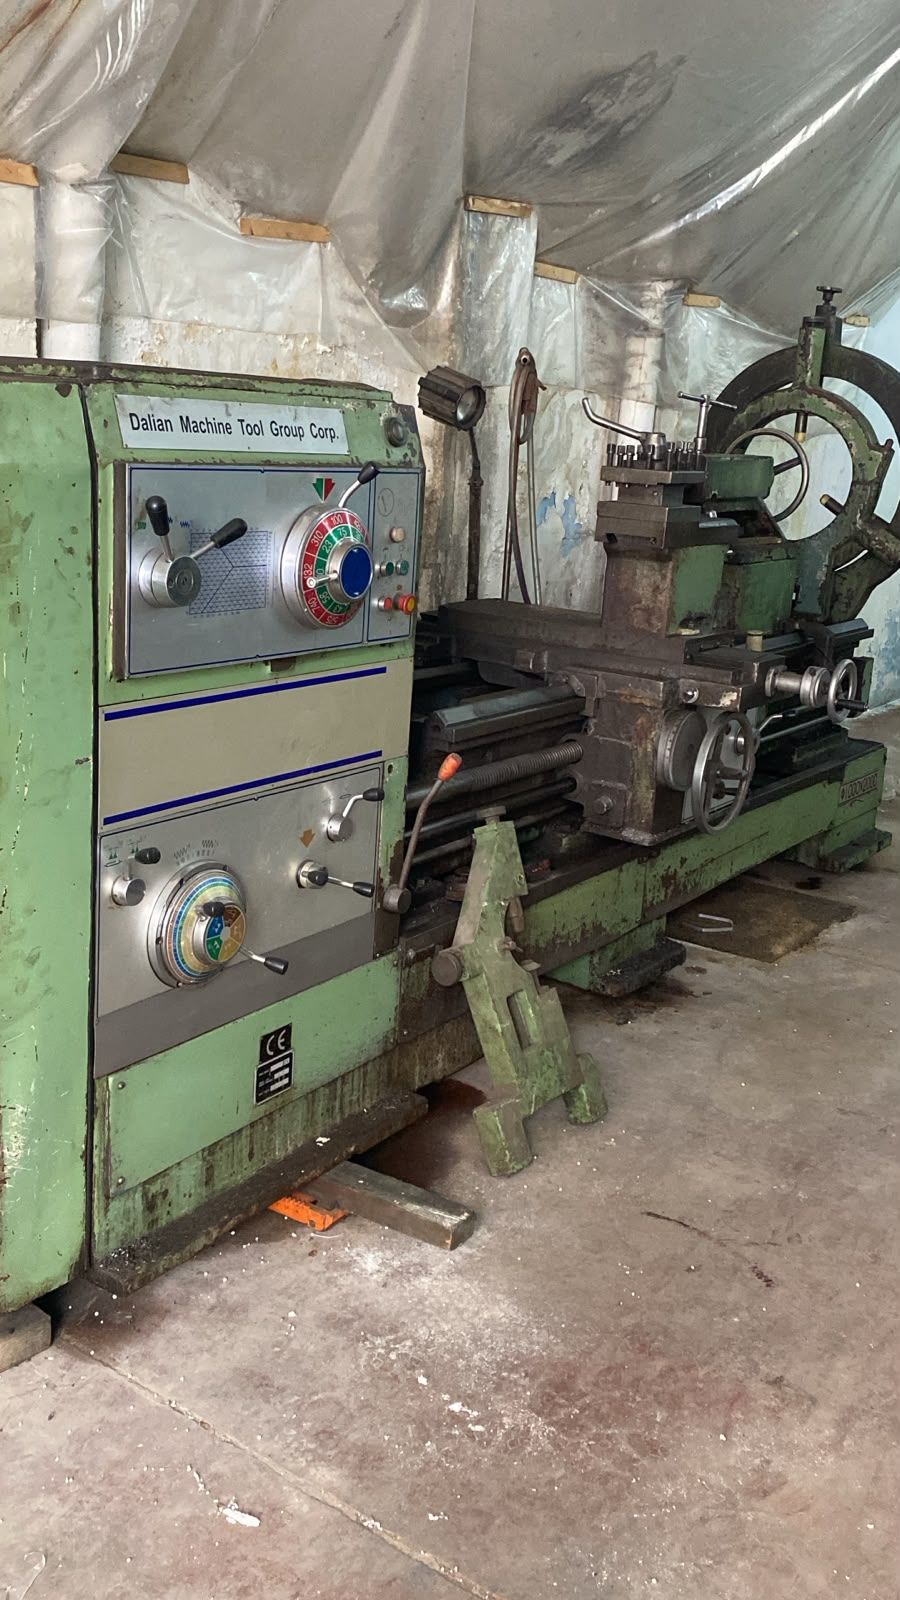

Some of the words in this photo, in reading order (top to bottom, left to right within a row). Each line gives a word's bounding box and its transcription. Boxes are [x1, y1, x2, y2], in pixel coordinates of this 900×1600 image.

[129, 412, 174, 432] Dalian
[179, 415, 232, 435] Machine
[238, 419, 264, 436] Tool
[270, 420, 304, 441] Group
[310, 422, 339, 442] Corp.
[311, 530, 324, 547] 310
[322, 540, 332, 553] 23
[266, 1029, 286, 1056] CE
